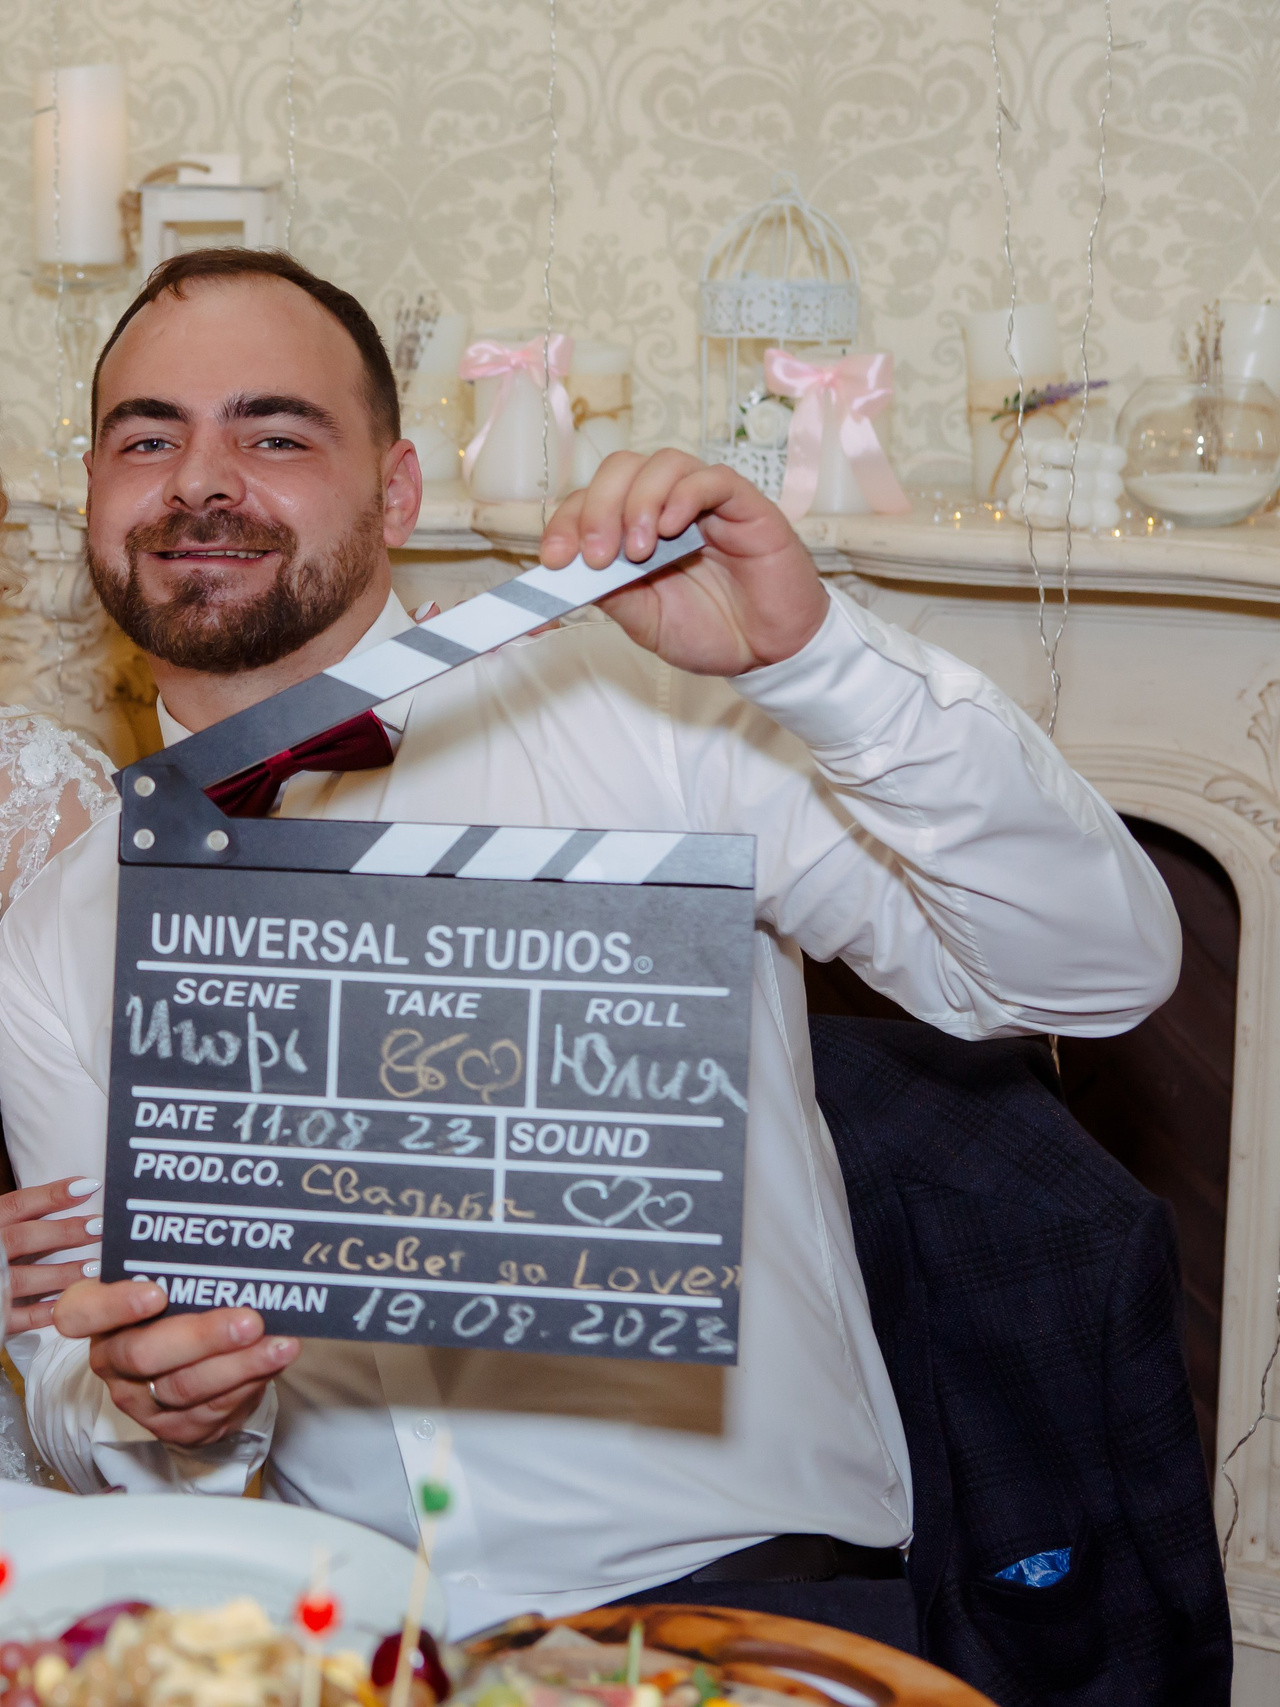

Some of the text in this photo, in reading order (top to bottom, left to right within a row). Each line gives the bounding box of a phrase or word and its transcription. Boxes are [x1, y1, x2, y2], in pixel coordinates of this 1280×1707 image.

[151, 912, 410, 965] UNIVERSAL
[173, 977, 301, 1010] SCENE
[383, 989, 483, 1020] TAKE
[584, 997, 687, 1028] ROLL
[550, 1023, 749, 1114] Юлия
[134, 1101, 218, 1132] DATE
[508, 1121, 652, 1160] SOUND
[133, 1152, 284, 1188] PROD.CO.
[129, 1213, 295, 1251] DIRECTOR
[131, 1274, 329, 1314] AMERAMAN
